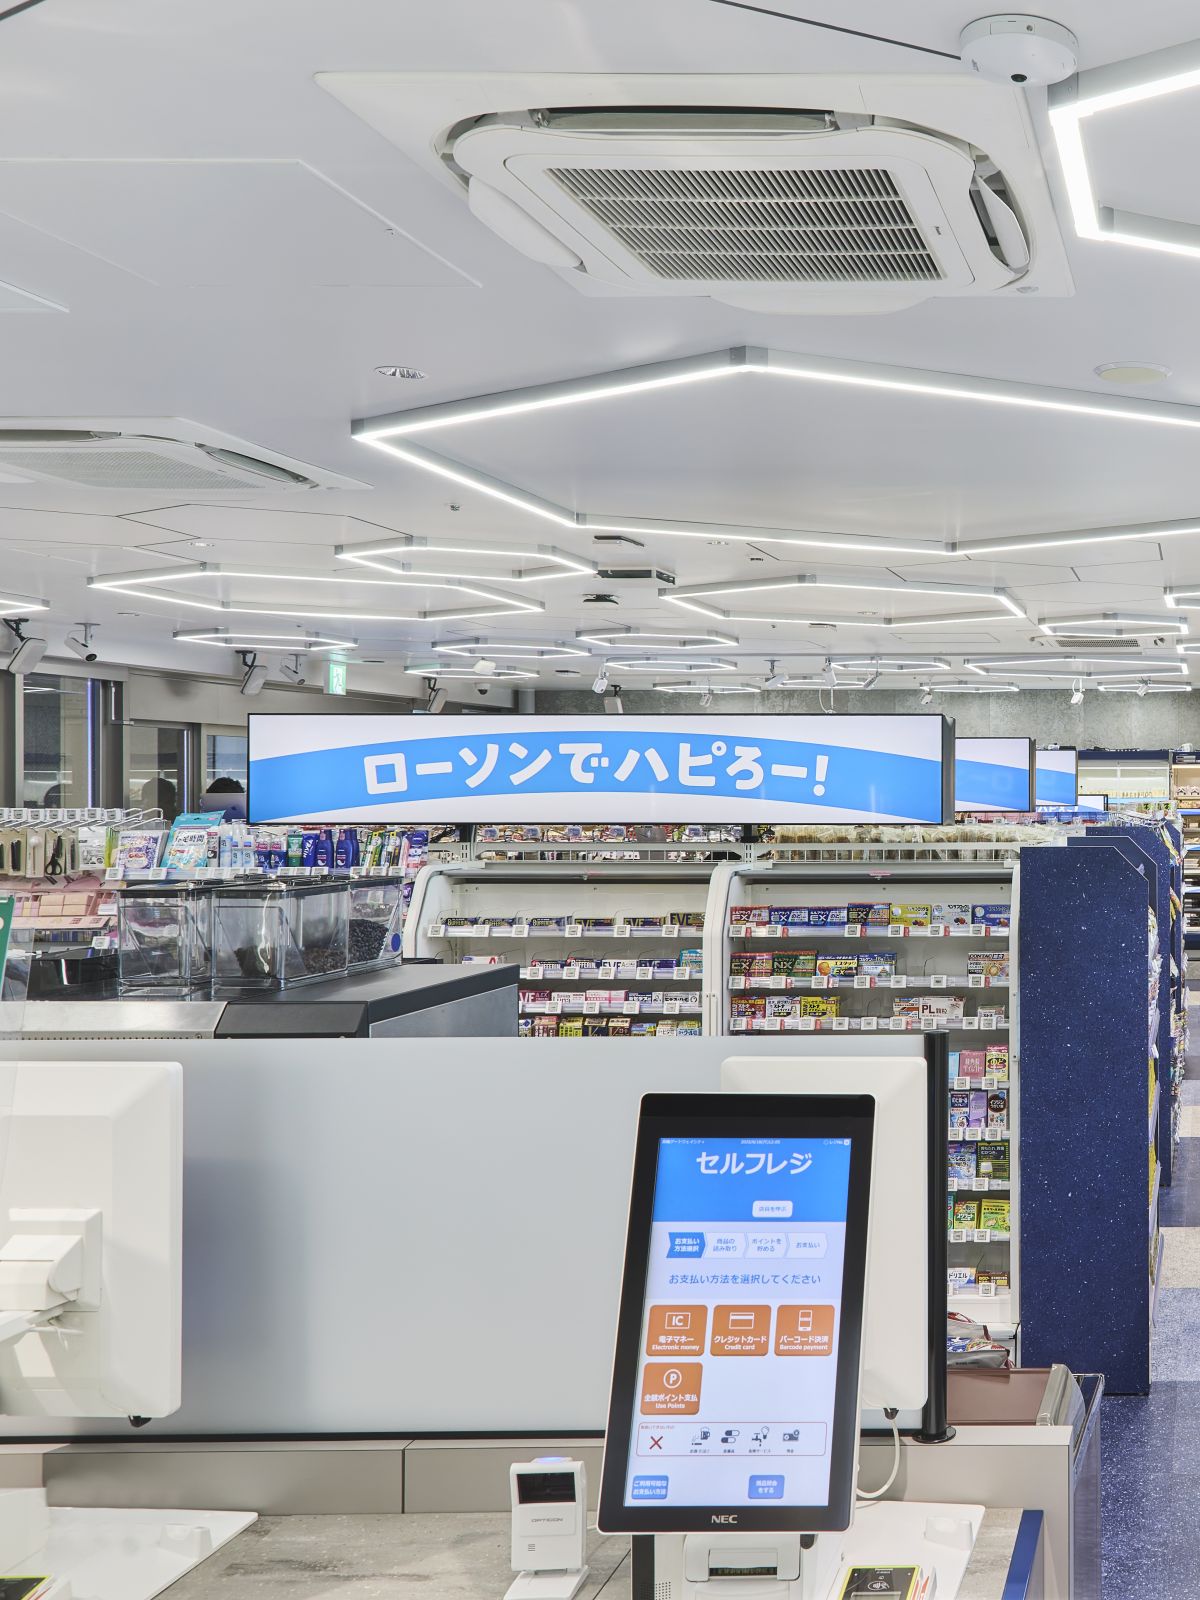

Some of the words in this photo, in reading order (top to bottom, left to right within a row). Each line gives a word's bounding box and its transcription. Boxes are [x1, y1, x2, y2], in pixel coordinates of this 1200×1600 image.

[302, 839, 314, 858] NIVEA
[624, 919, 645, 928] EVE
[670, 912, 692, 926] EVE
[774, 961, 793, 969] NX
[519, 992, 536, 1003] VE
[921, 1004, 935, 1014] PL
[696, 1151, 813, 1175] セルフレジ
[796, 1241, 820, 1249] お支払い
[668, 1273, 821, 1285] お支払い方法を選択してください
[671, 1315, 684, 1326] IC
[658, 1335, 694, 1344] 電子マネー
[713, 1335, 767, 1344] クレジットカード
[779, 1335, 829, 1344] バーコード決済
[711, 1514, 738, 1524] NEC
